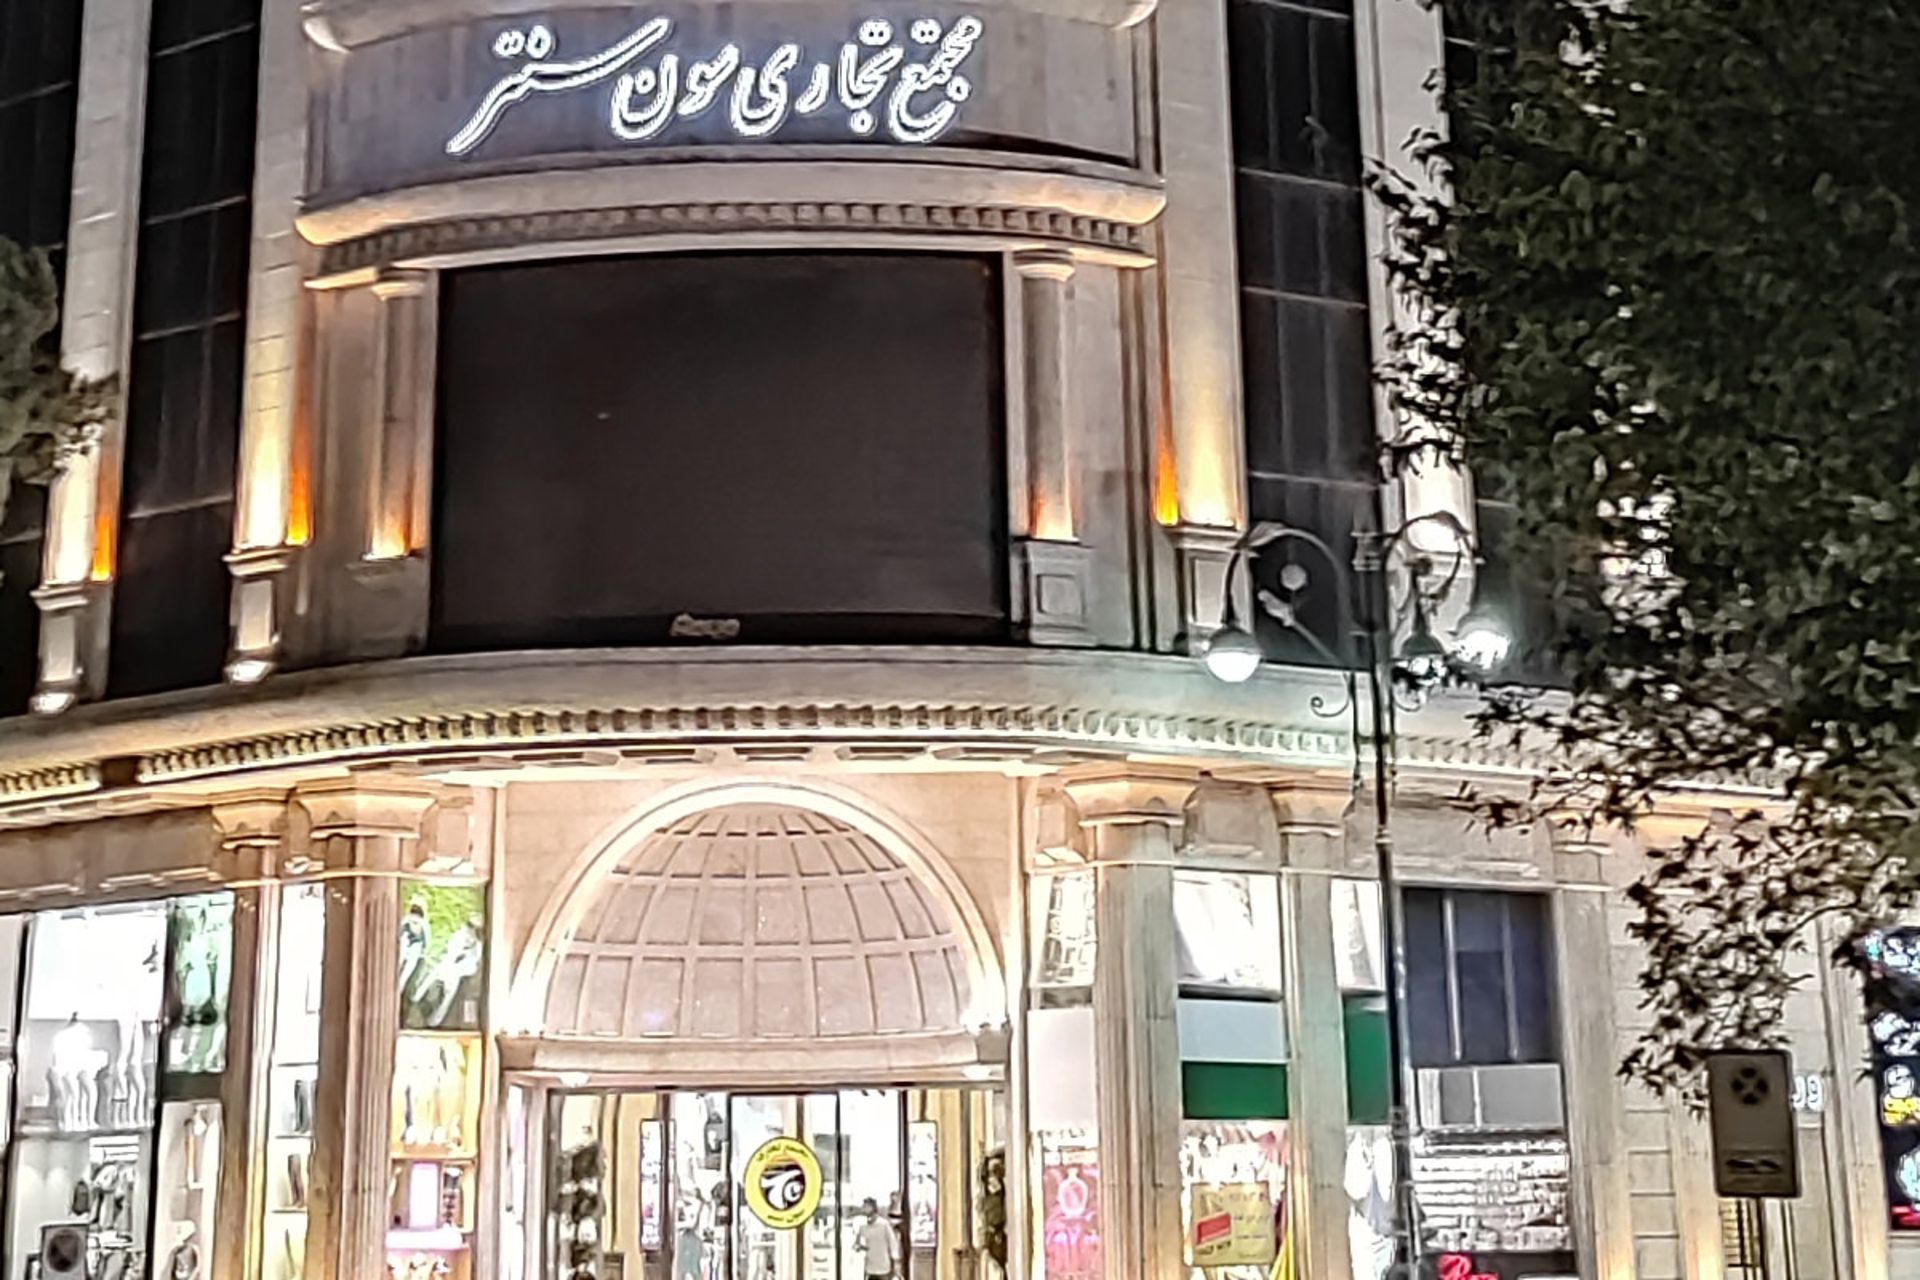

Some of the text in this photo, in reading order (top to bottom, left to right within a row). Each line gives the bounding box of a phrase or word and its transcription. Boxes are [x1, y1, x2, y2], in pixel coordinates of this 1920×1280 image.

[446, 17, 982, 154] مجتمع تجاری سون سنتر
